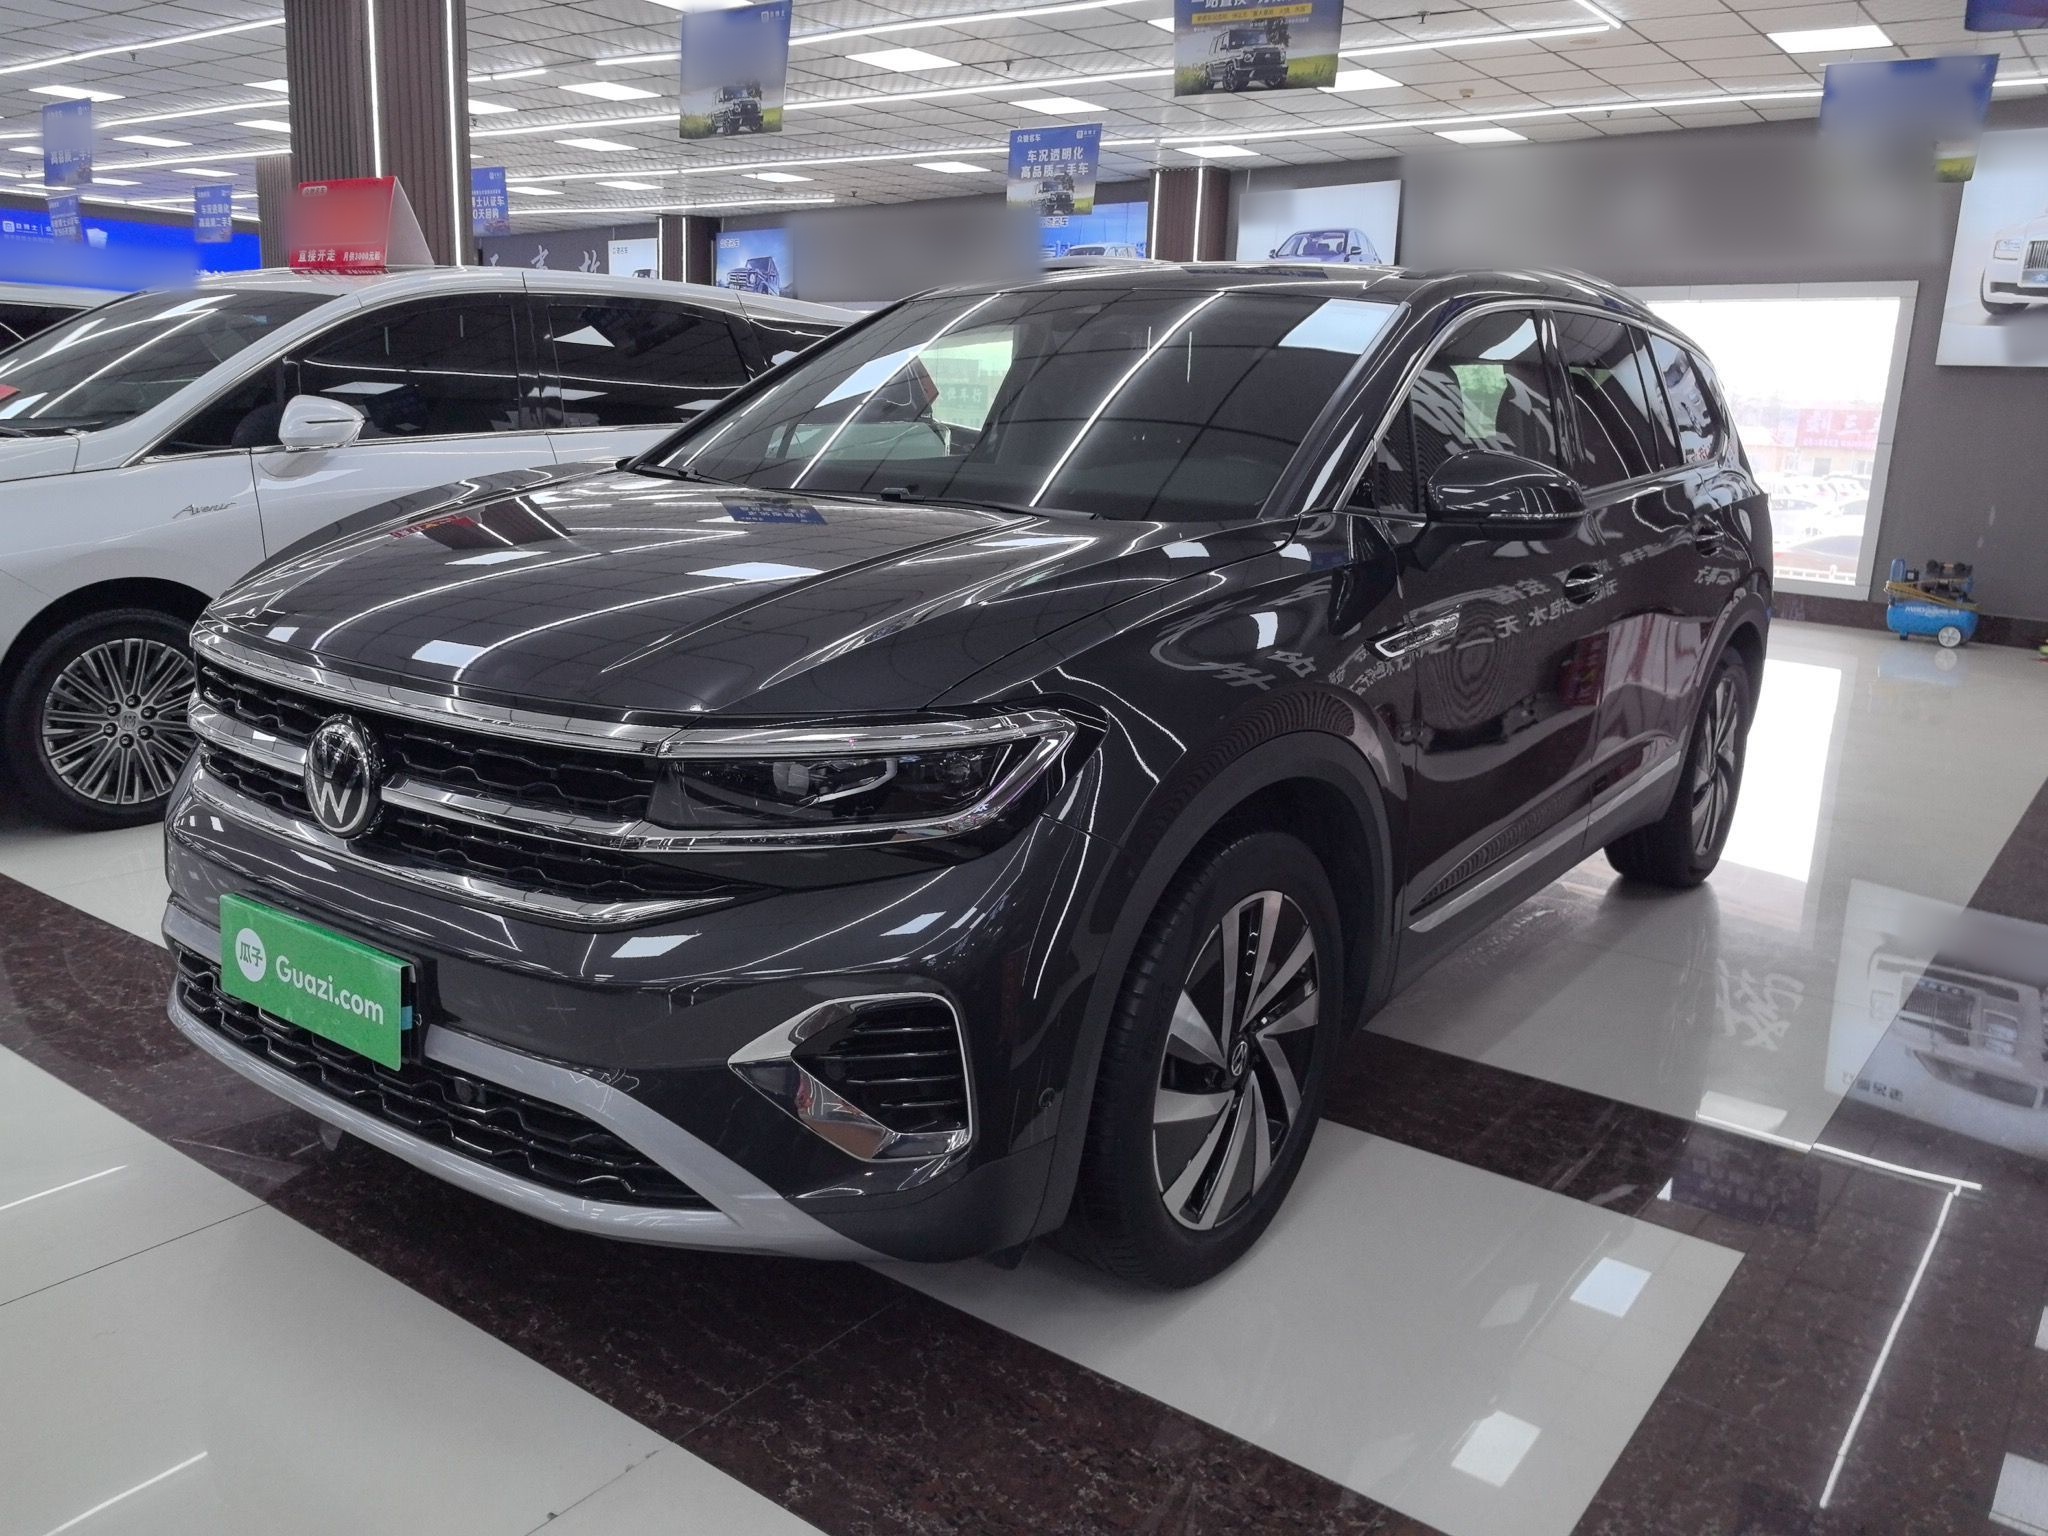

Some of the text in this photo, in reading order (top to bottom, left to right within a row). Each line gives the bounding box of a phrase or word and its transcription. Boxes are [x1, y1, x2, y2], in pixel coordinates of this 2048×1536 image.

[1027, 146, 1084, 163] 车况透明化
[1021, 162, 1089, 179] 高品质二手车
[298, 248, 335, 263] 直接开走
[239, 940, 263, 967] 瓜子
[275, 954, 384, 1025] Guazi.com
